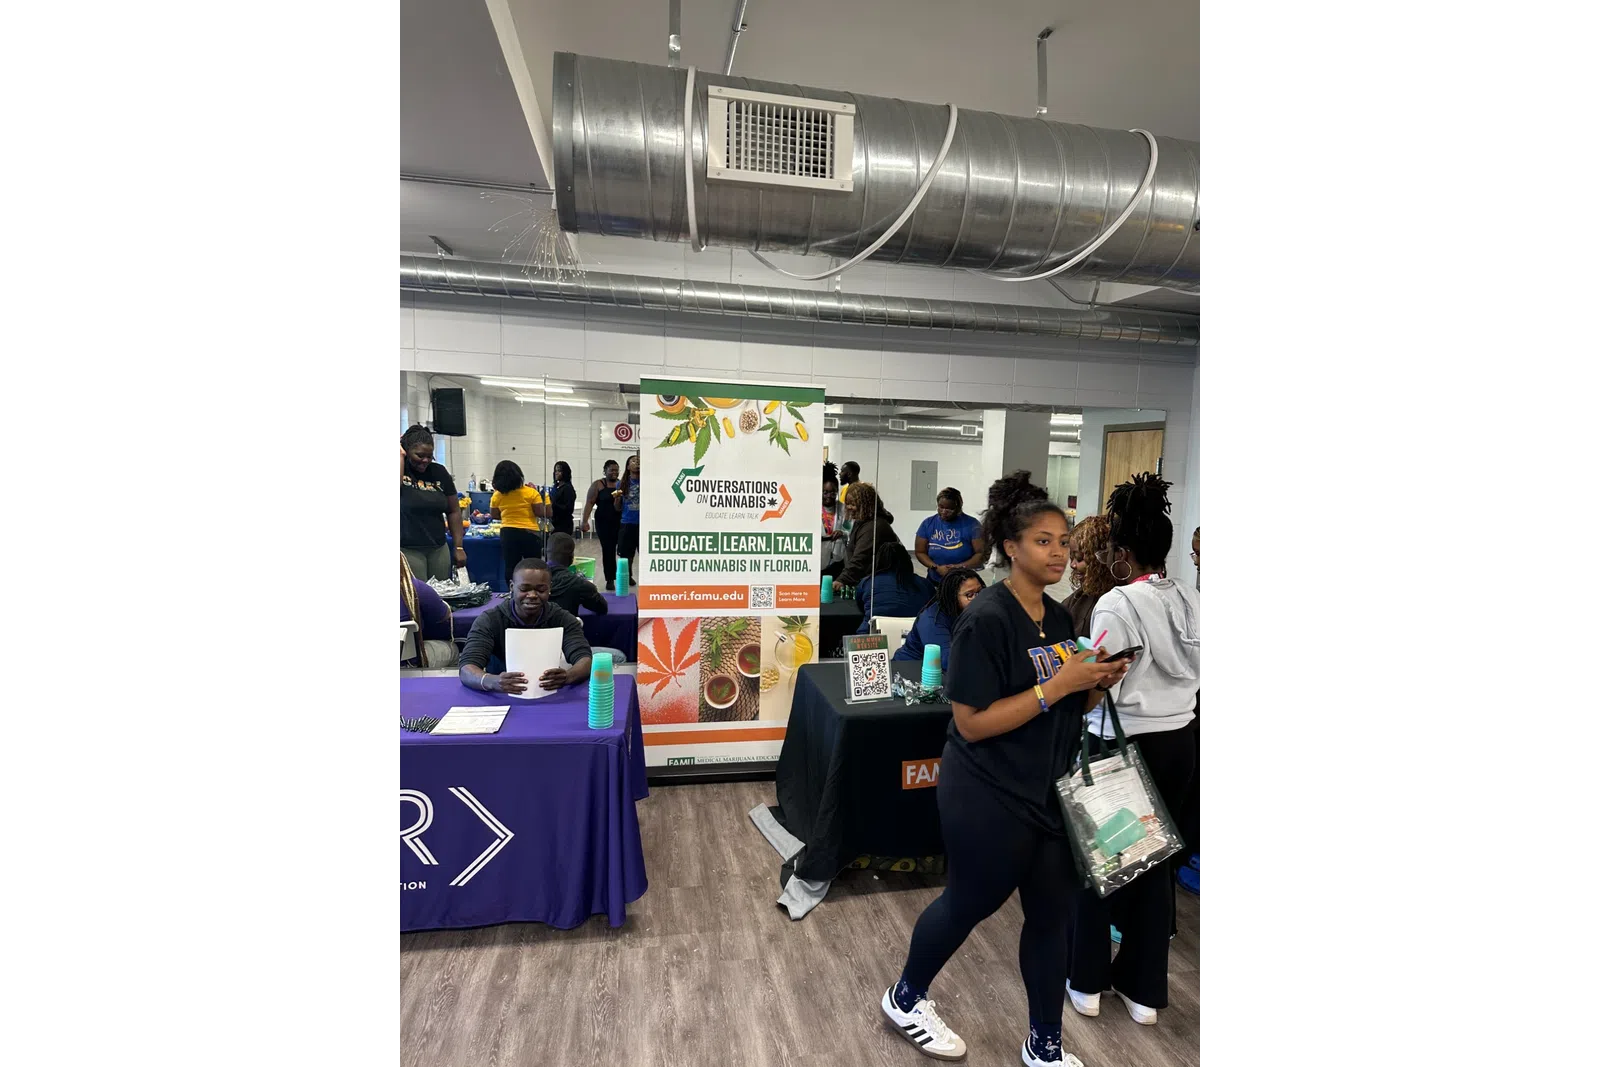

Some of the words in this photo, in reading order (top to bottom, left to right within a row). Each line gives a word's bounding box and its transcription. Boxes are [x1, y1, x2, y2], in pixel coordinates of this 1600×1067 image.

[686, 479, 778, 494] CONVERSATIONS
[696, 494, 708, 504] ON
[709, 494, 766, 508] CANNABIS
[651, 535, 717, 552] EDUCATE.
[723, 535, 770, 552] LEARN.
[776, 536, 812, 552] TALK.
[649, 559, 687, 572] ABOUT
[690, 559, 747, 572] CANNABIS
[750, 559, 761, 572] IN
[764, 559, 812, 572] FLORIDA.
[649, 591, 744, 601] mmeri.famu.edu
